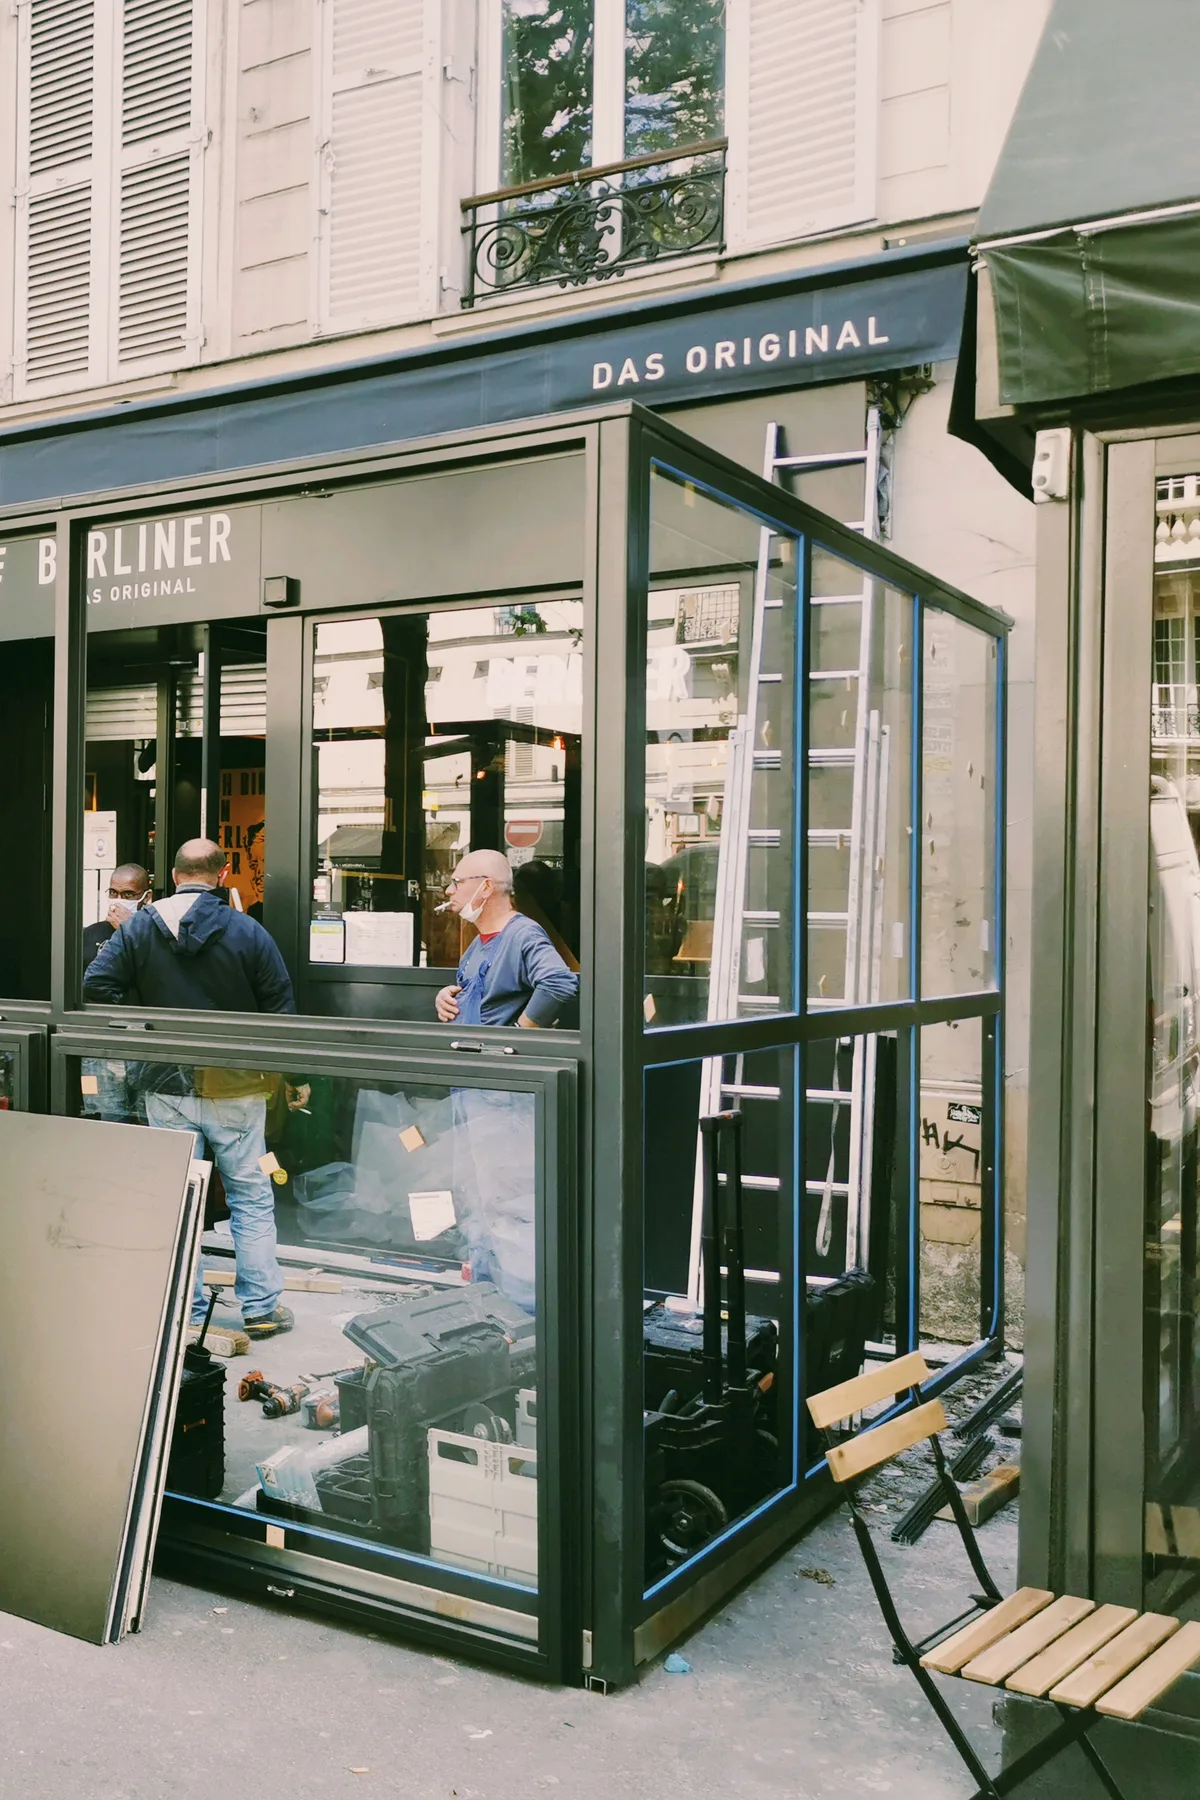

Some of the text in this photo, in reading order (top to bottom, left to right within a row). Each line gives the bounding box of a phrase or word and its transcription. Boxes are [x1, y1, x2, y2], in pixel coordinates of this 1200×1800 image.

[592, 316, 890, 389] DAS ORIGINAL
[38, 513, 232, 585] BRLINER
[110, 577, 196, 601] ORIGINAL
